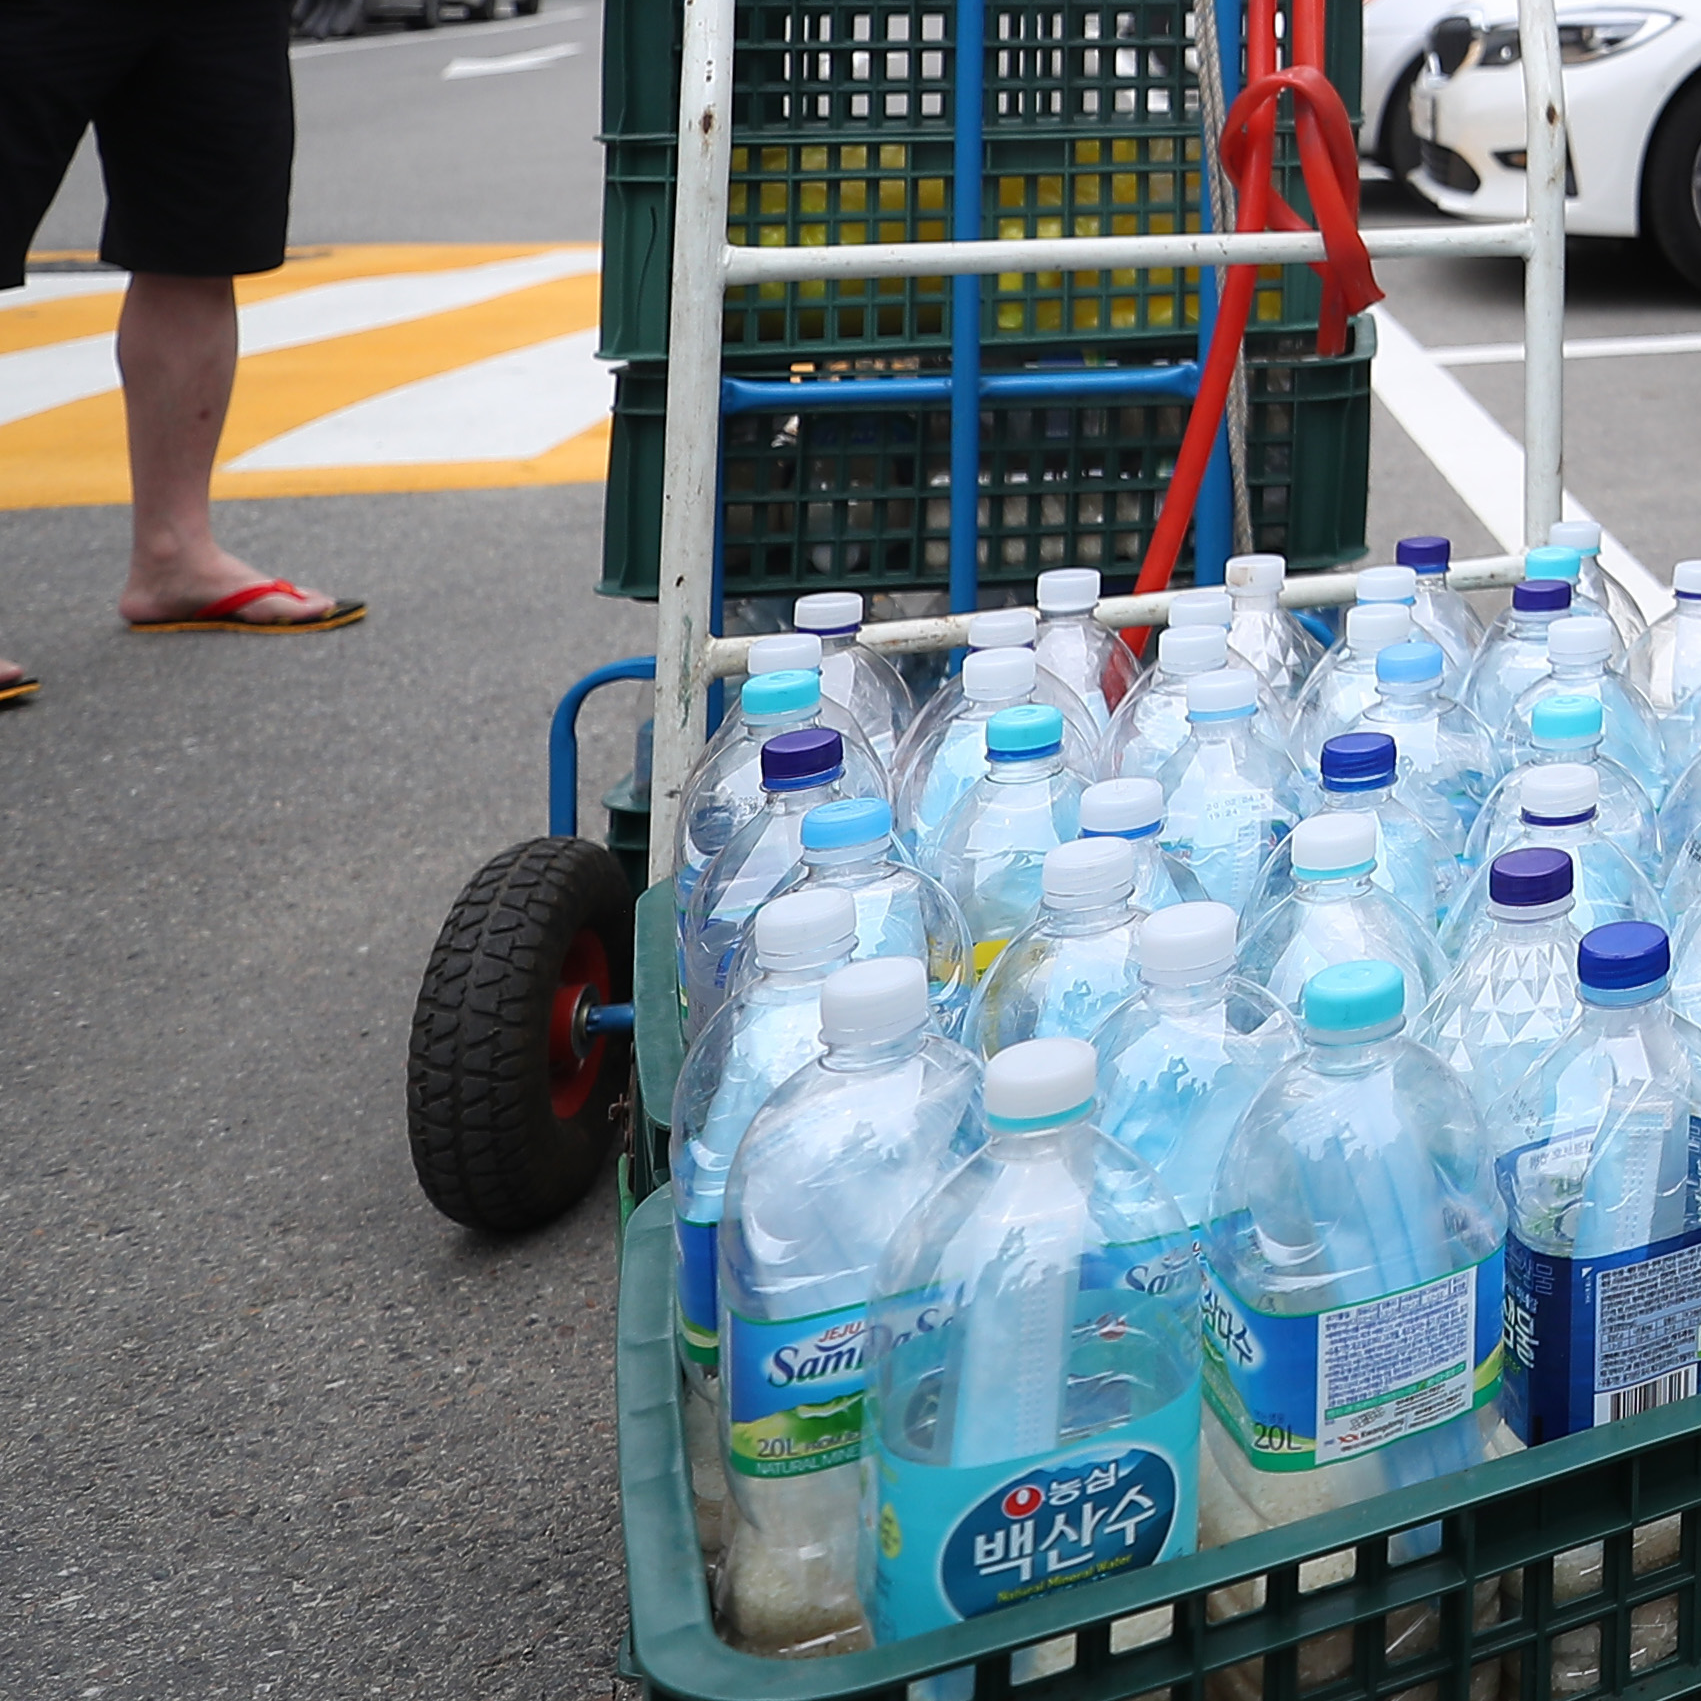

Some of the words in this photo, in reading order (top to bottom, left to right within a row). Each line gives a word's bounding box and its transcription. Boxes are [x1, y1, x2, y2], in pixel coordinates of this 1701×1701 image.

[818, 1321, 861, 1343] JEJU
[755, 1458, 820, 1475] NATURAL
[1048, 1460, 1119, 1507] 농심
[973, 1483, 1157, 1583] 백산수
[1046, 1566, 1094, 1590] Mineral
[1095, 1552, 1133, 1572] Water
